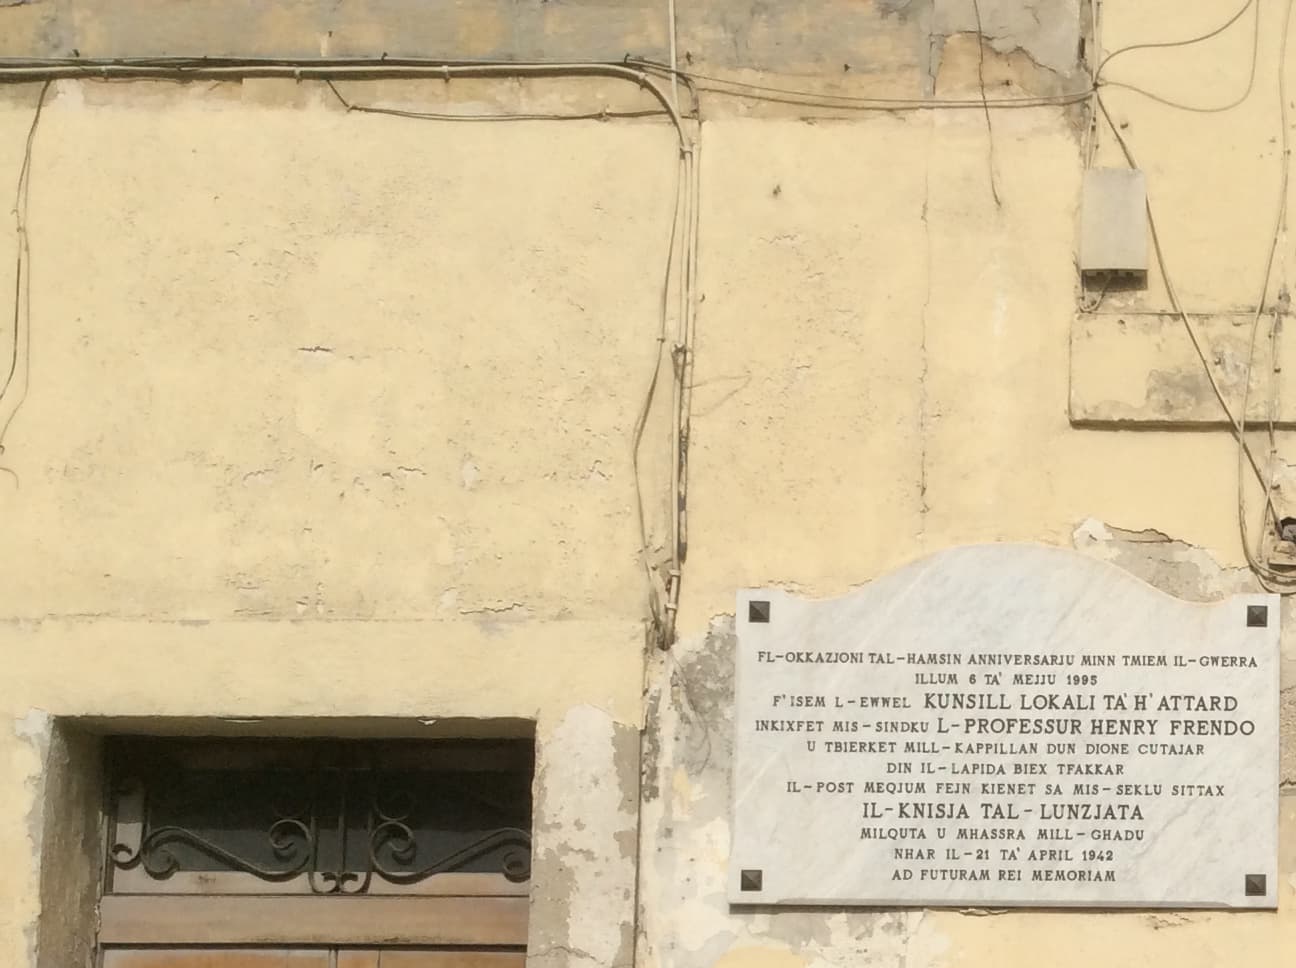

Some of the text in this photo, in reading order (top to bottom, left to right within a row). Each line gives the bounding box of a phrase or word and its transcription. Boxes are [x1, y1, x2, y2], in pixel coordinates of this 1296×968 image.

[968, 654, 1074, 666] ANNIVERSARJU
[1081, 655, 1116, 666] MINN
[1122, 655, 1167, 667] TMIEM
[915, 672, 1097, 685] ILLUM 6 TA' MEJJU 1995
[924, 693, 1011, 709] KUNSILL
[1020, 695, 1094, 710] LOKALI
[1104, 694, 1126, 711] TA'
[756, 720, 824, 731] INKIXFET
[1091, 720, 1158, 735] HENRY
[1170, 720, 1255, 736] FRENDO
[807, 741, 815, 751] U
[825, 741, 896, 753] TBIERKET
[1047, 744, 1075, 754] DUN
[1086, 744, 1129, 754] DIONE
[1138, 744, 1204, 755] CUTAJAR
[887, 763, 912, 773] DIN
[1014, 764, 1047, 775] BIEX
[1057, 764, 1124, 775] TFAKKAR
[864, 782, 926, 794] MEQJUM
[936, 783, 971, 794] FEJN
[981, 784, 1036, 795] KIENET
[1045, 784, 1063, 795] SA
[1171, 785, 1224, 796] SITTAX
[860, 828, 926, 840] MILQUTA
[937, 828, 946, 839] U
[894, 848, 935, 860] NHAR
[1000, 847, 1020, 861] TA'
[1028, 850, 1073, 861] APRIL
[1082, 850, 1113, 861] 1942
[892, 870, 1116, 881] AD FUTURAM REI MEMORIAM
